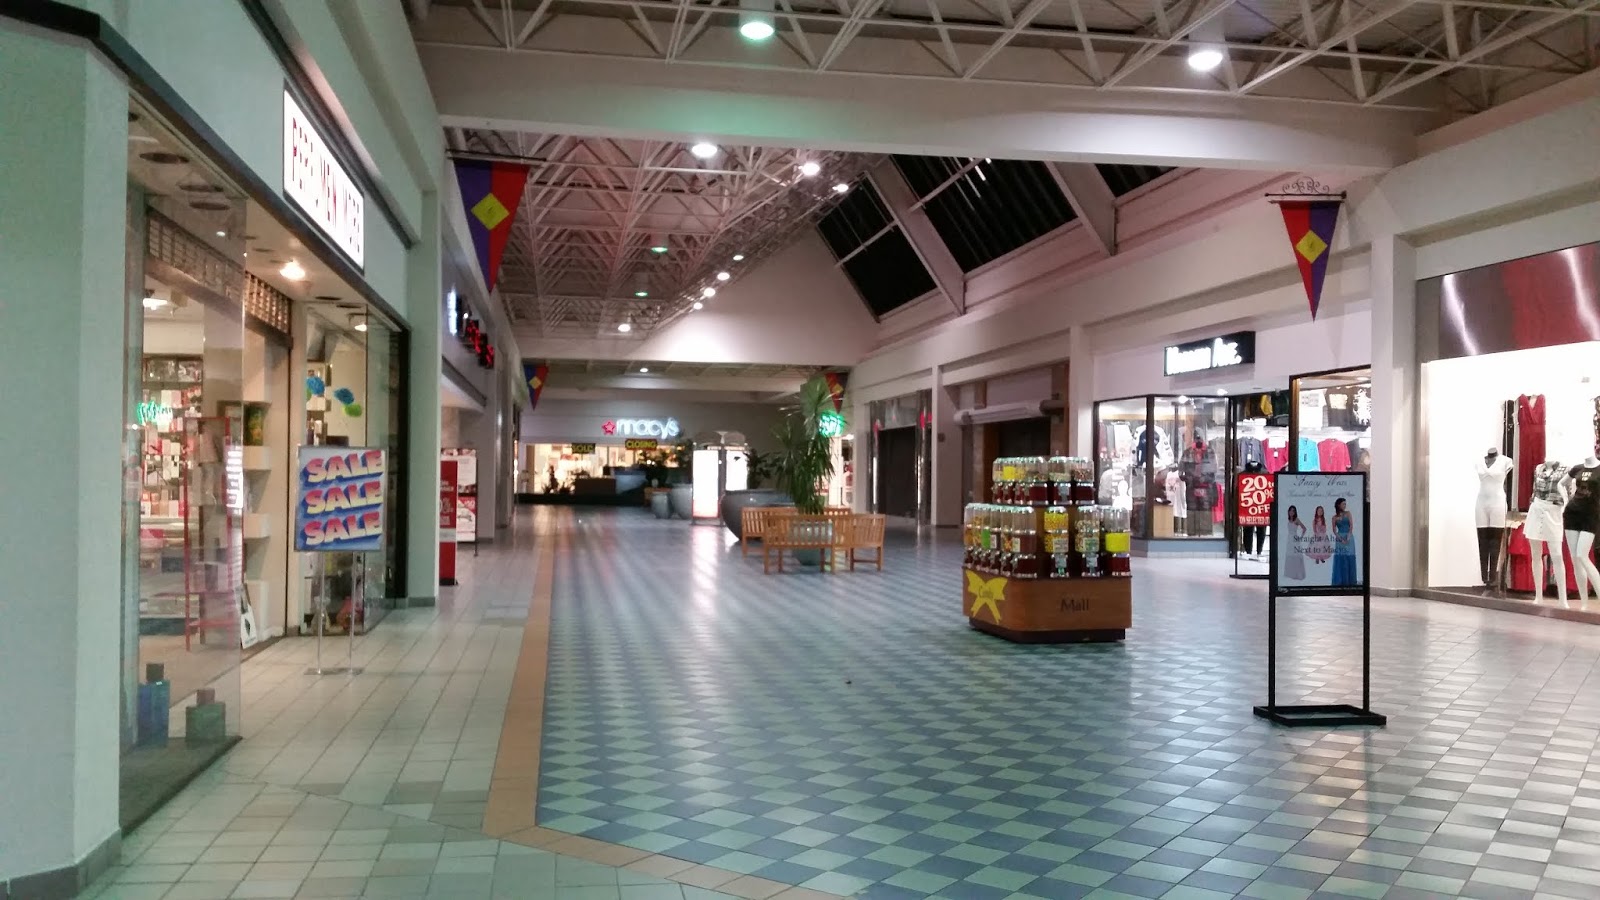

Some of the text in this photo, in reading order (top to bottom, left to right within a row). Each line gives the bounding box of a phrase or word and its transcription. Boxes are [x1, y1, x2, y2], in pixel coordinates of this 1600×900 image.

[303, 450, 384, 485] SALE
[1241, 475, 1268, 492] 20
[302, 481, 384, 516] SALE
[1248, 504, 1270, 515] OFF
[301, 511, 383, 546] SALE
[1293, 535, 1322, 544] Straight
[1060, 598, 1089, 612] Mall
